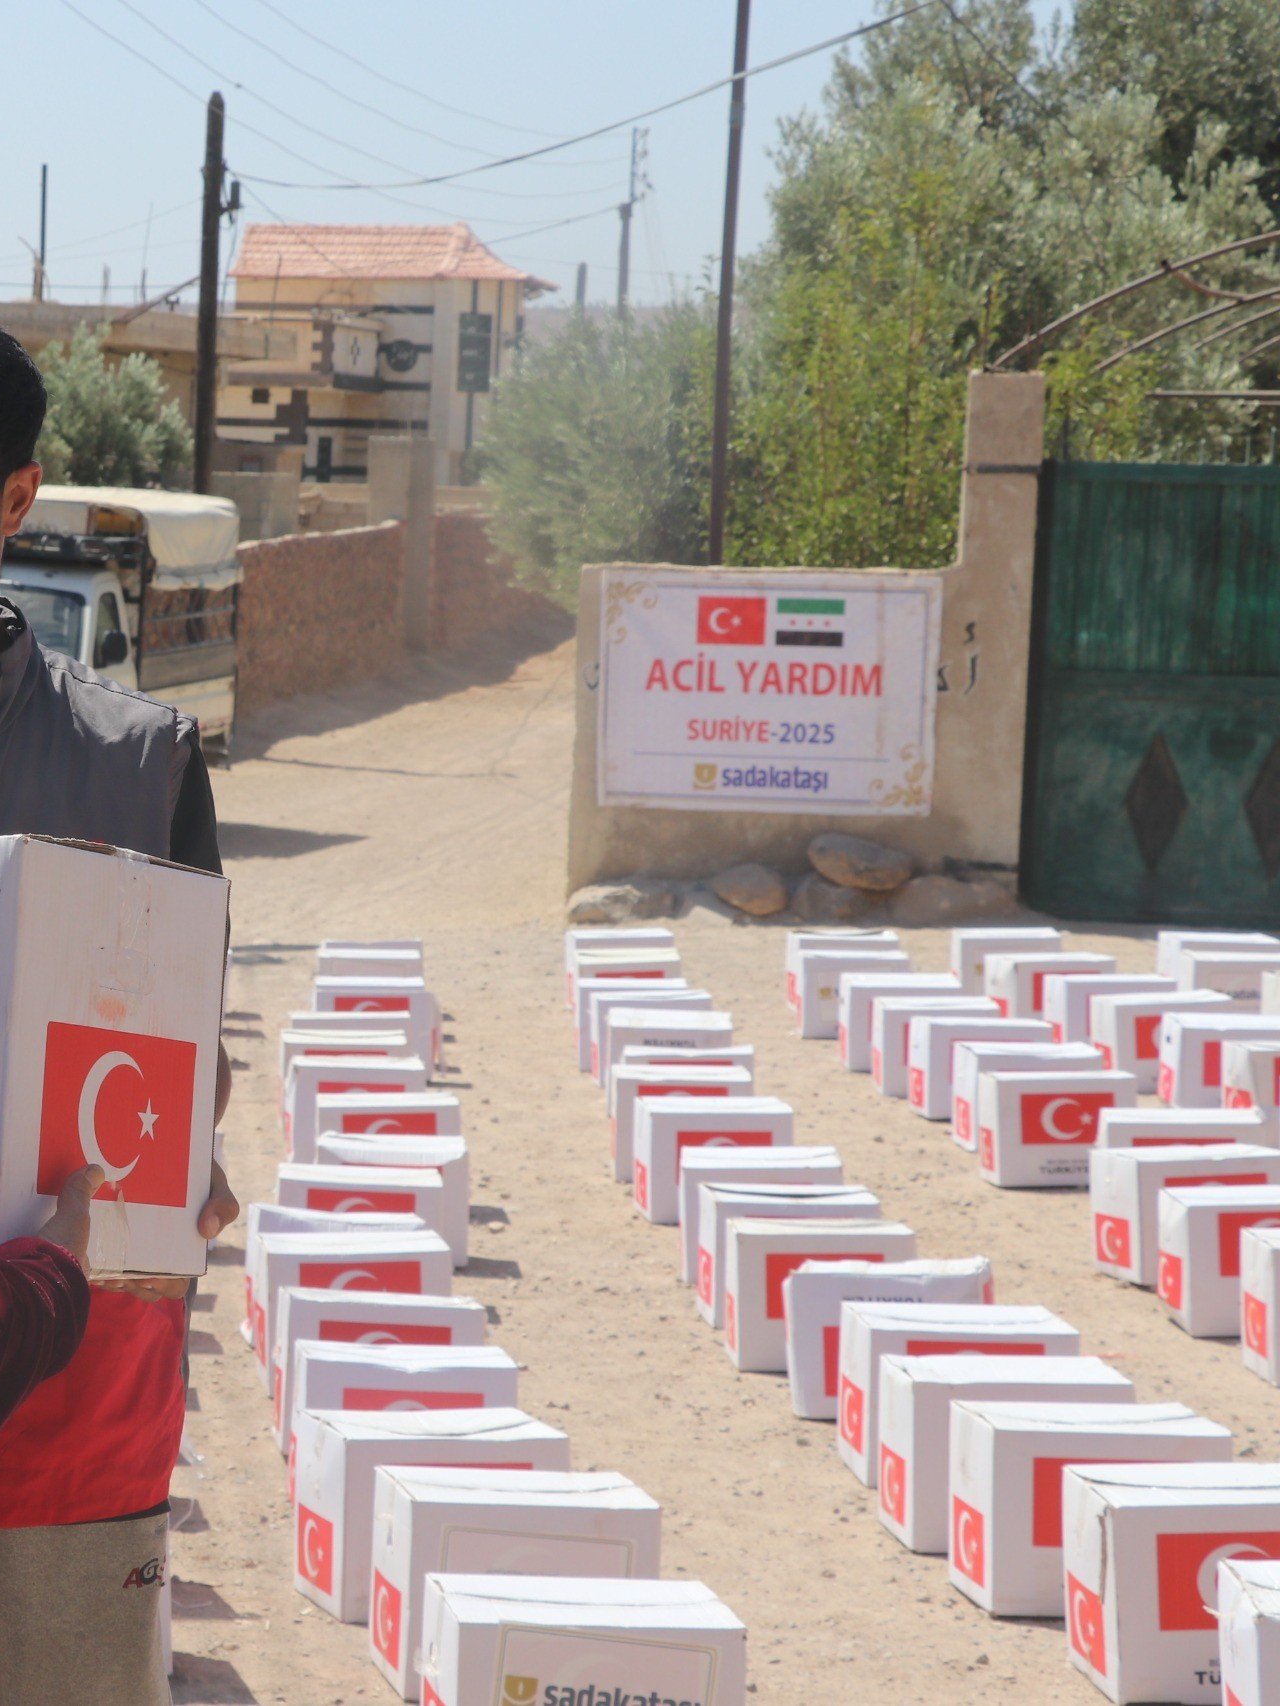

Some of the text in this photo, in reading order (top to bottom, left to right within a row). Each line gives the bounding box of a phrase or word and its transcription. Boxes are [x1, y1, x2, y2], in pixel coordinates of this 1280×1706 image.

[645, 652, 725, 692] ACİL
[736, 660, 883, 697] YARDIM
[687, 715, 836, 744] SURİYE-2025
[722, 765, 829, 793] sadakataşı
